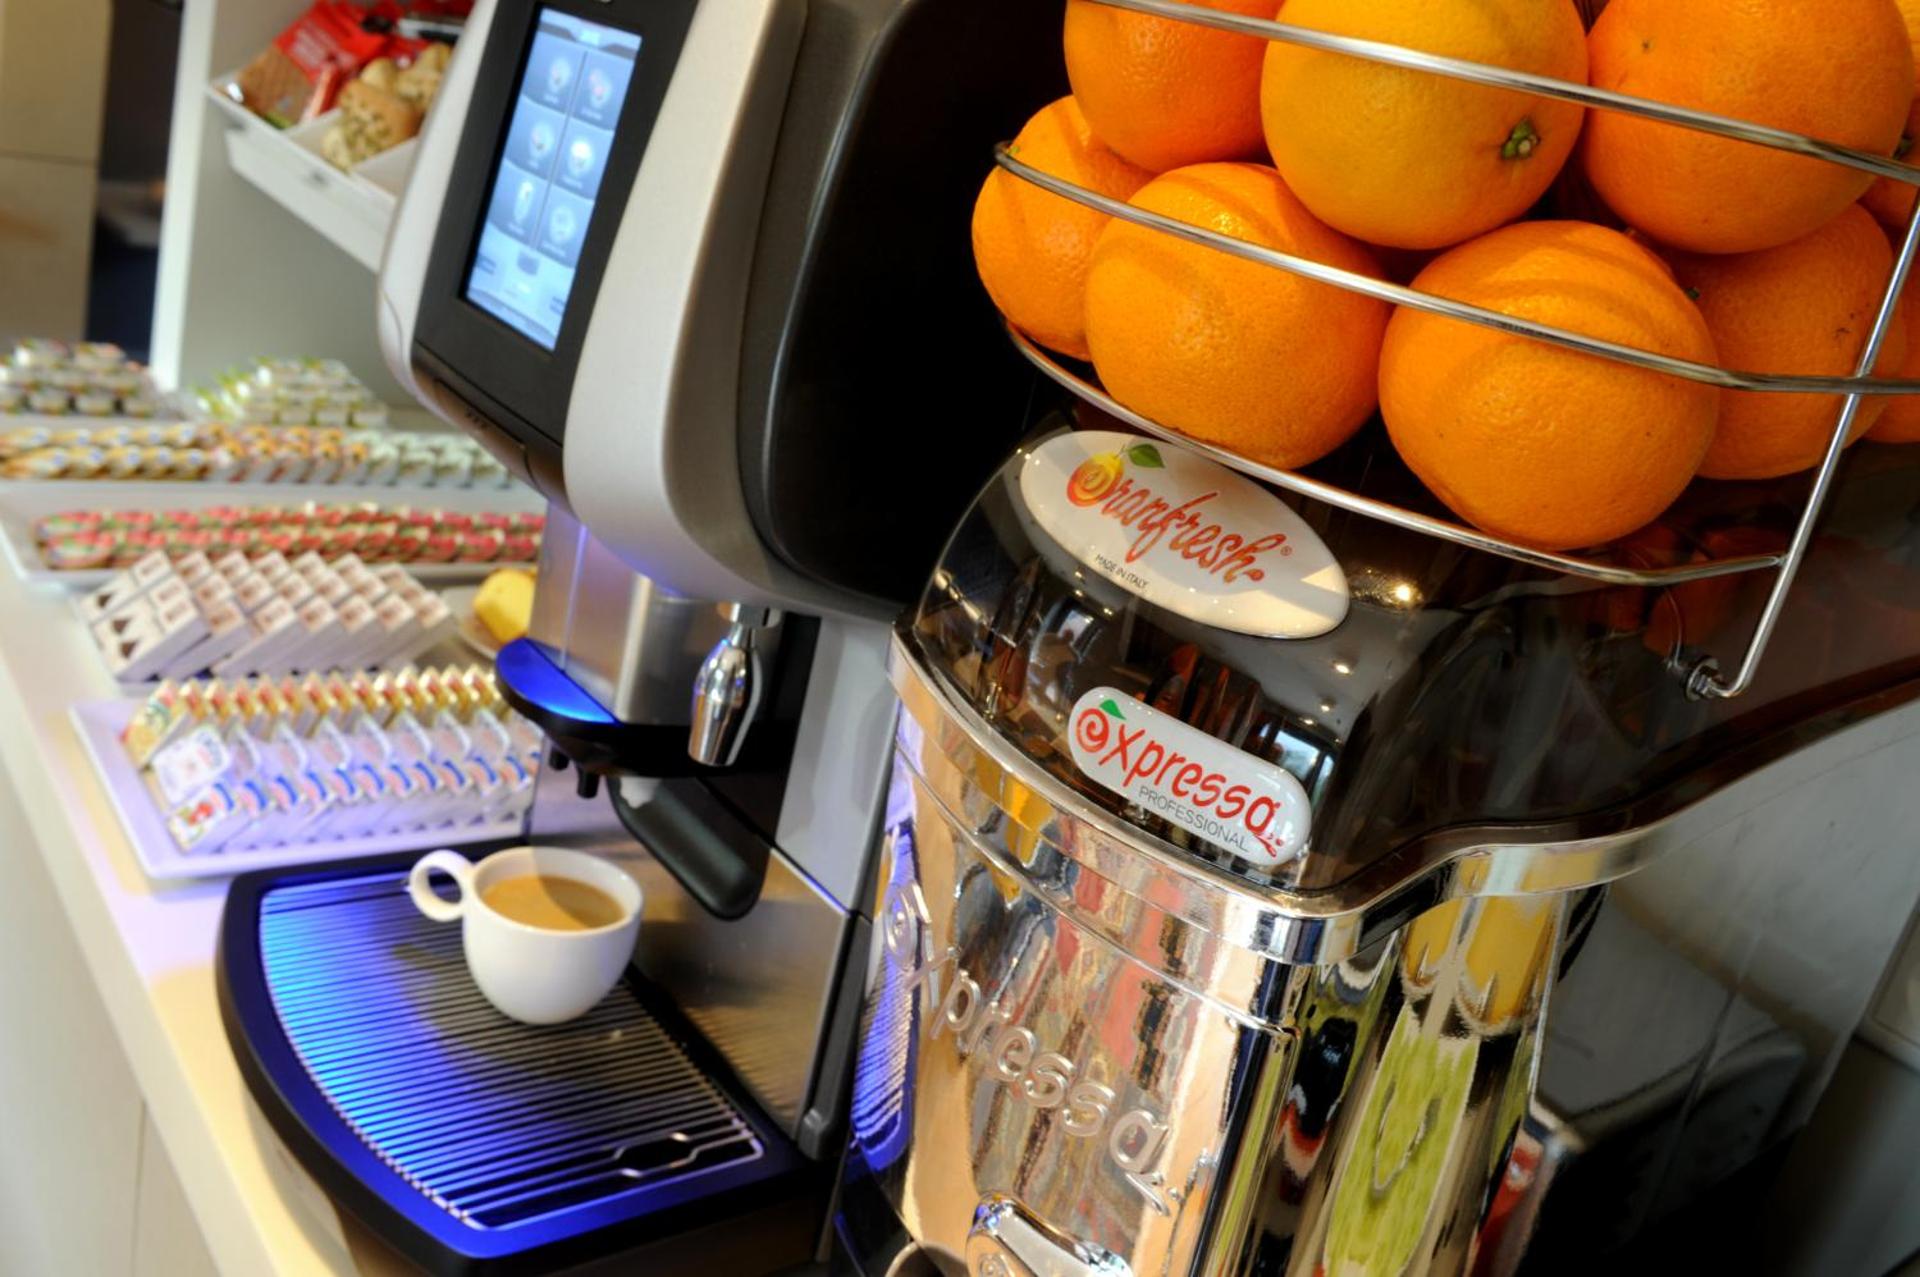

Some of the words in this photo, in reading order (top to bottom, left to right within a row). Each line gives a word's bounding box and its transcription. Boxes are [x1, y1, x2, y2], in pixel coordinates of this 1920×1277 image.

[1096, 554, 1116, 572] MADE
[1127, 573, 1148, 588] ITALY
[1139, 785, 1250, 852] PROFESSIONAL
